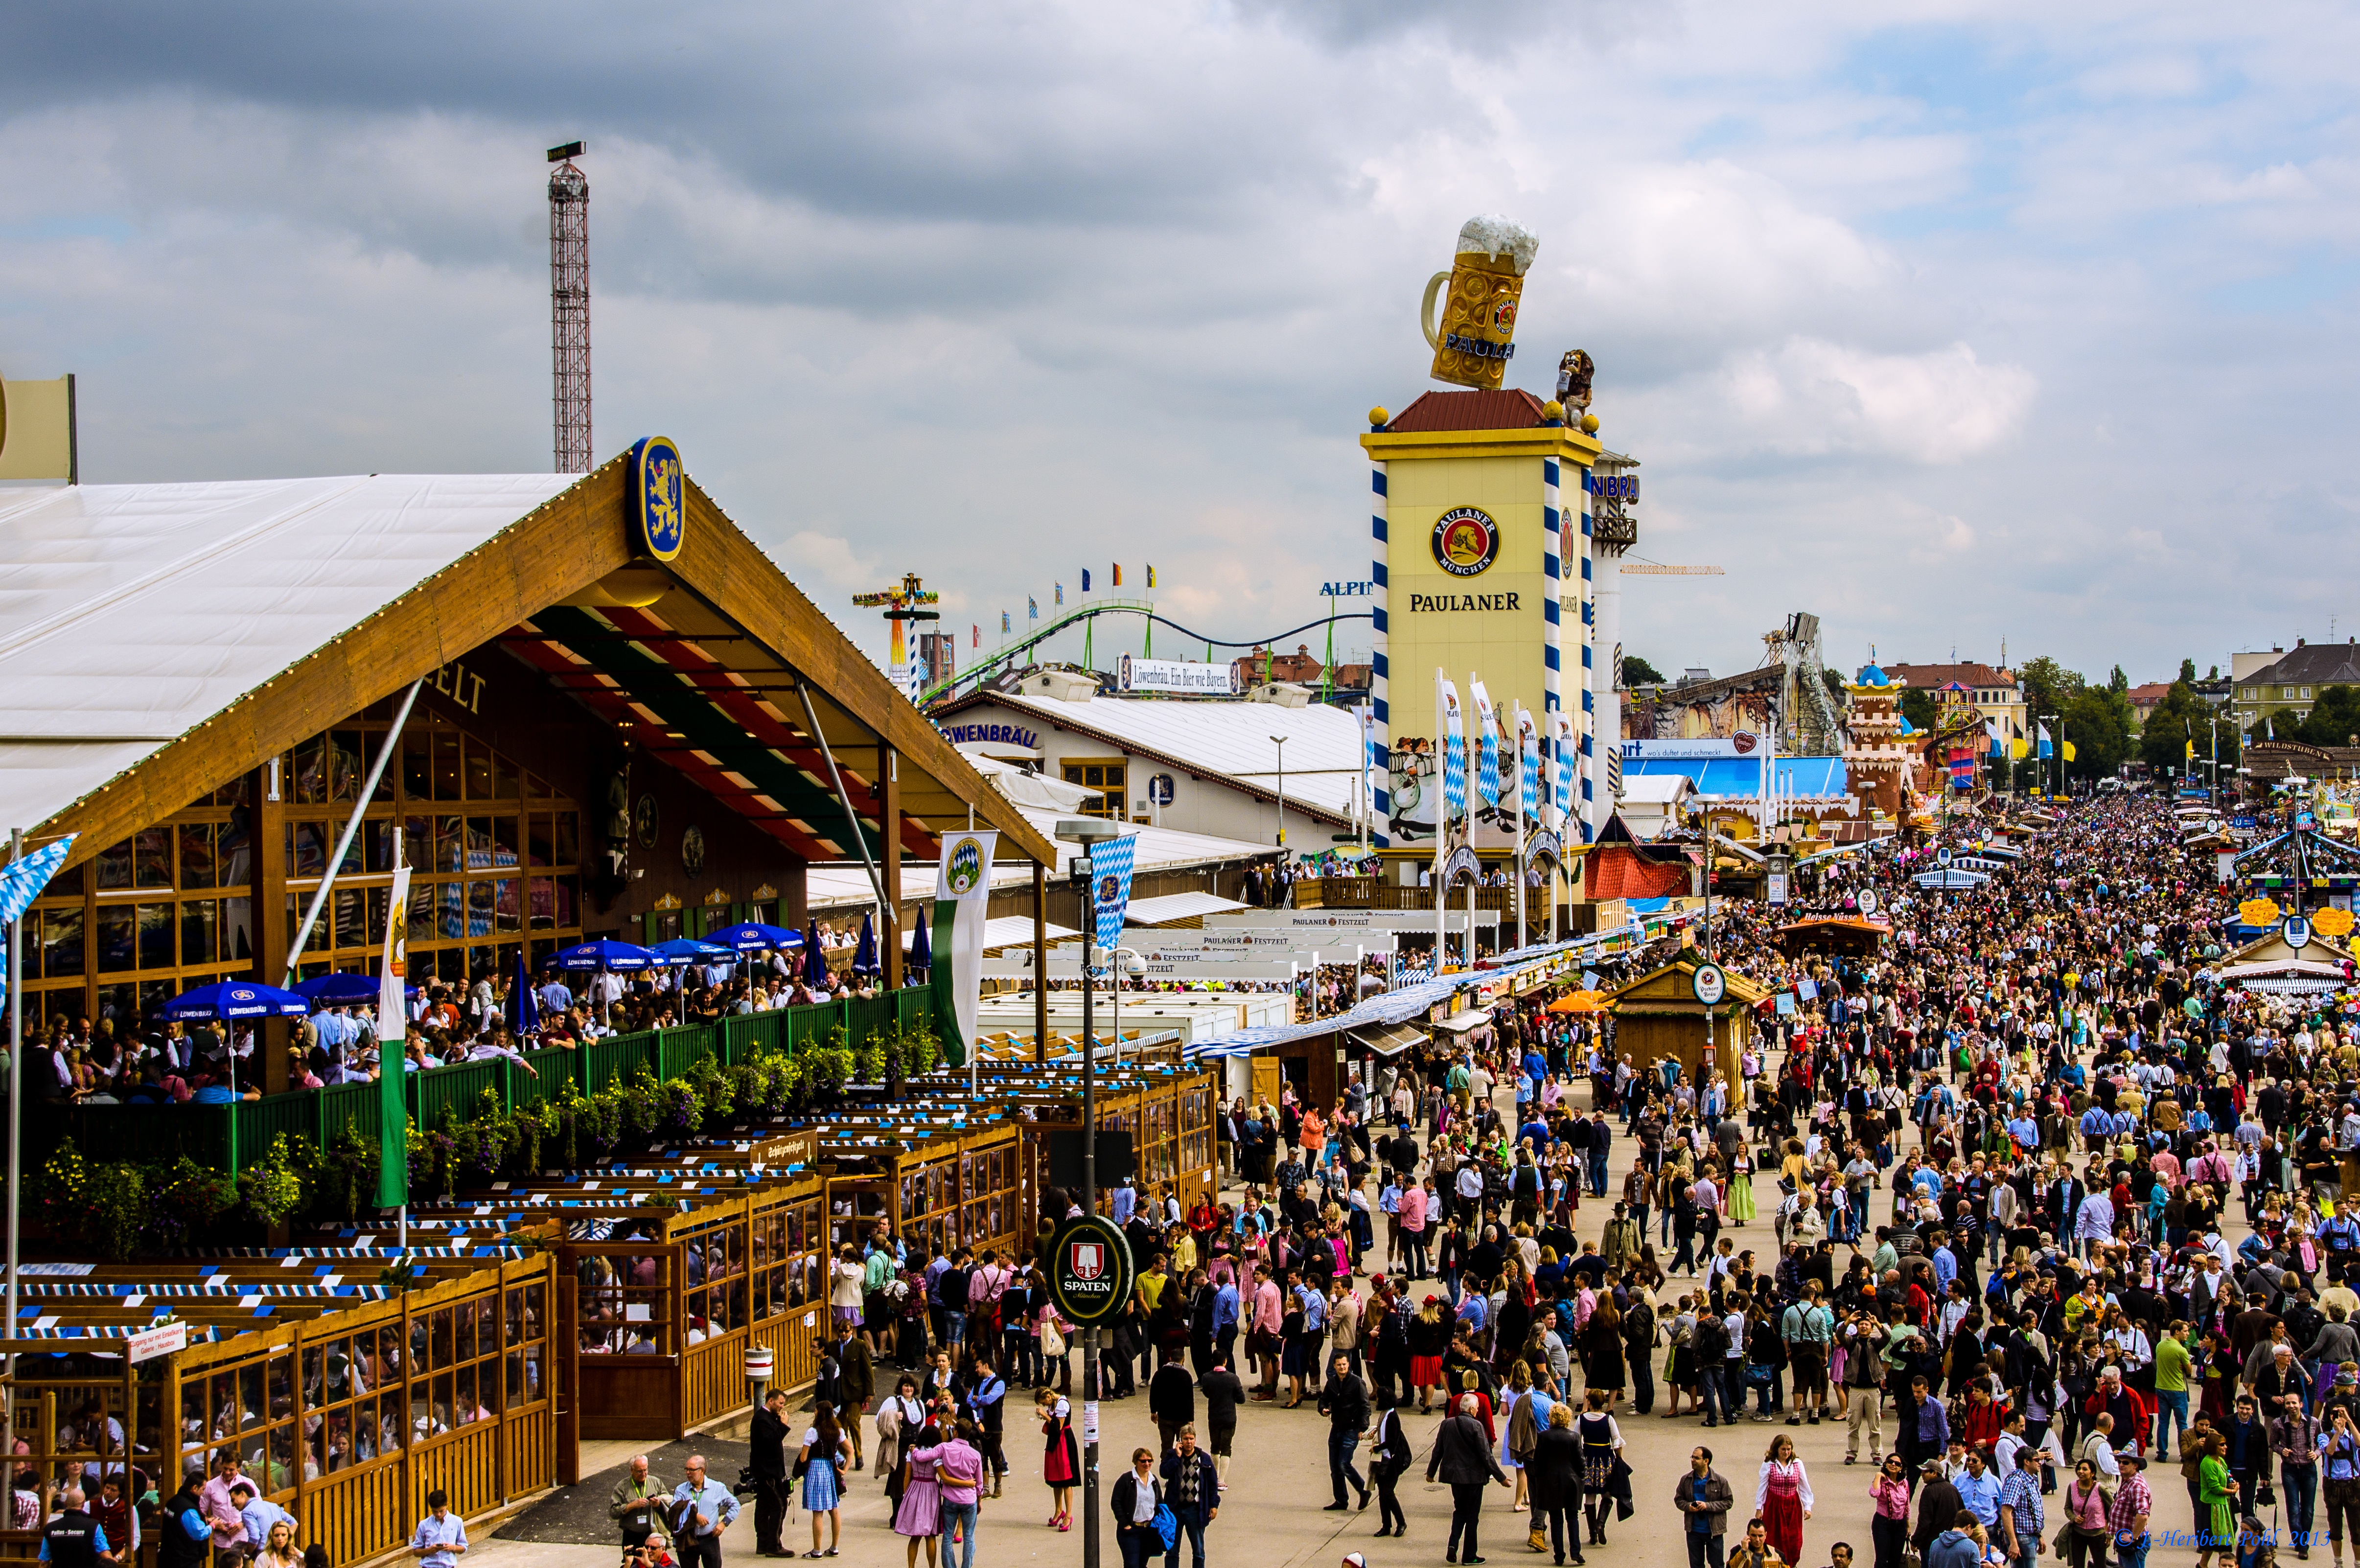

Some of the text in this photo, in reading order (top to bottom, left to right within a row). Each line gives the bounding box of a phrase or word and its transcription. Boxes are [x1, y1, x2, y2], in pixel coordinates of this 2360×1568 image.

[1444, 333, 1514, 359] PAULA
[1435, 509, 1495, 535] PAULANER
[1440, 557, 1491, 575] MÜNCHEN
[1410, 593, 1521, 612] PAULANER
[1171, 668, 1181, 686] Ein
[1183, 669, 1194, 686] Bier
[1196, 669, 1205, 687] wie
[1207, 669, 1227, 692] Bayern.
[2264, 742, 2322, 758] WILDSTUBEN
[1526, 832, 1561, 867] PAULANERGARTEN
[1445, 849, 1481, 891] PAULANERGARTEN
[1805, 912, 1857, 921] Heisse Nüsse
[229, 1006, 266, 1015] LÖWENBRÄU
[1064, 1281, 1111, 1291] SPATEN
[131, 1338, 147, 1347] Zugang
[158, 1340, 175, 1349] Hausbox
